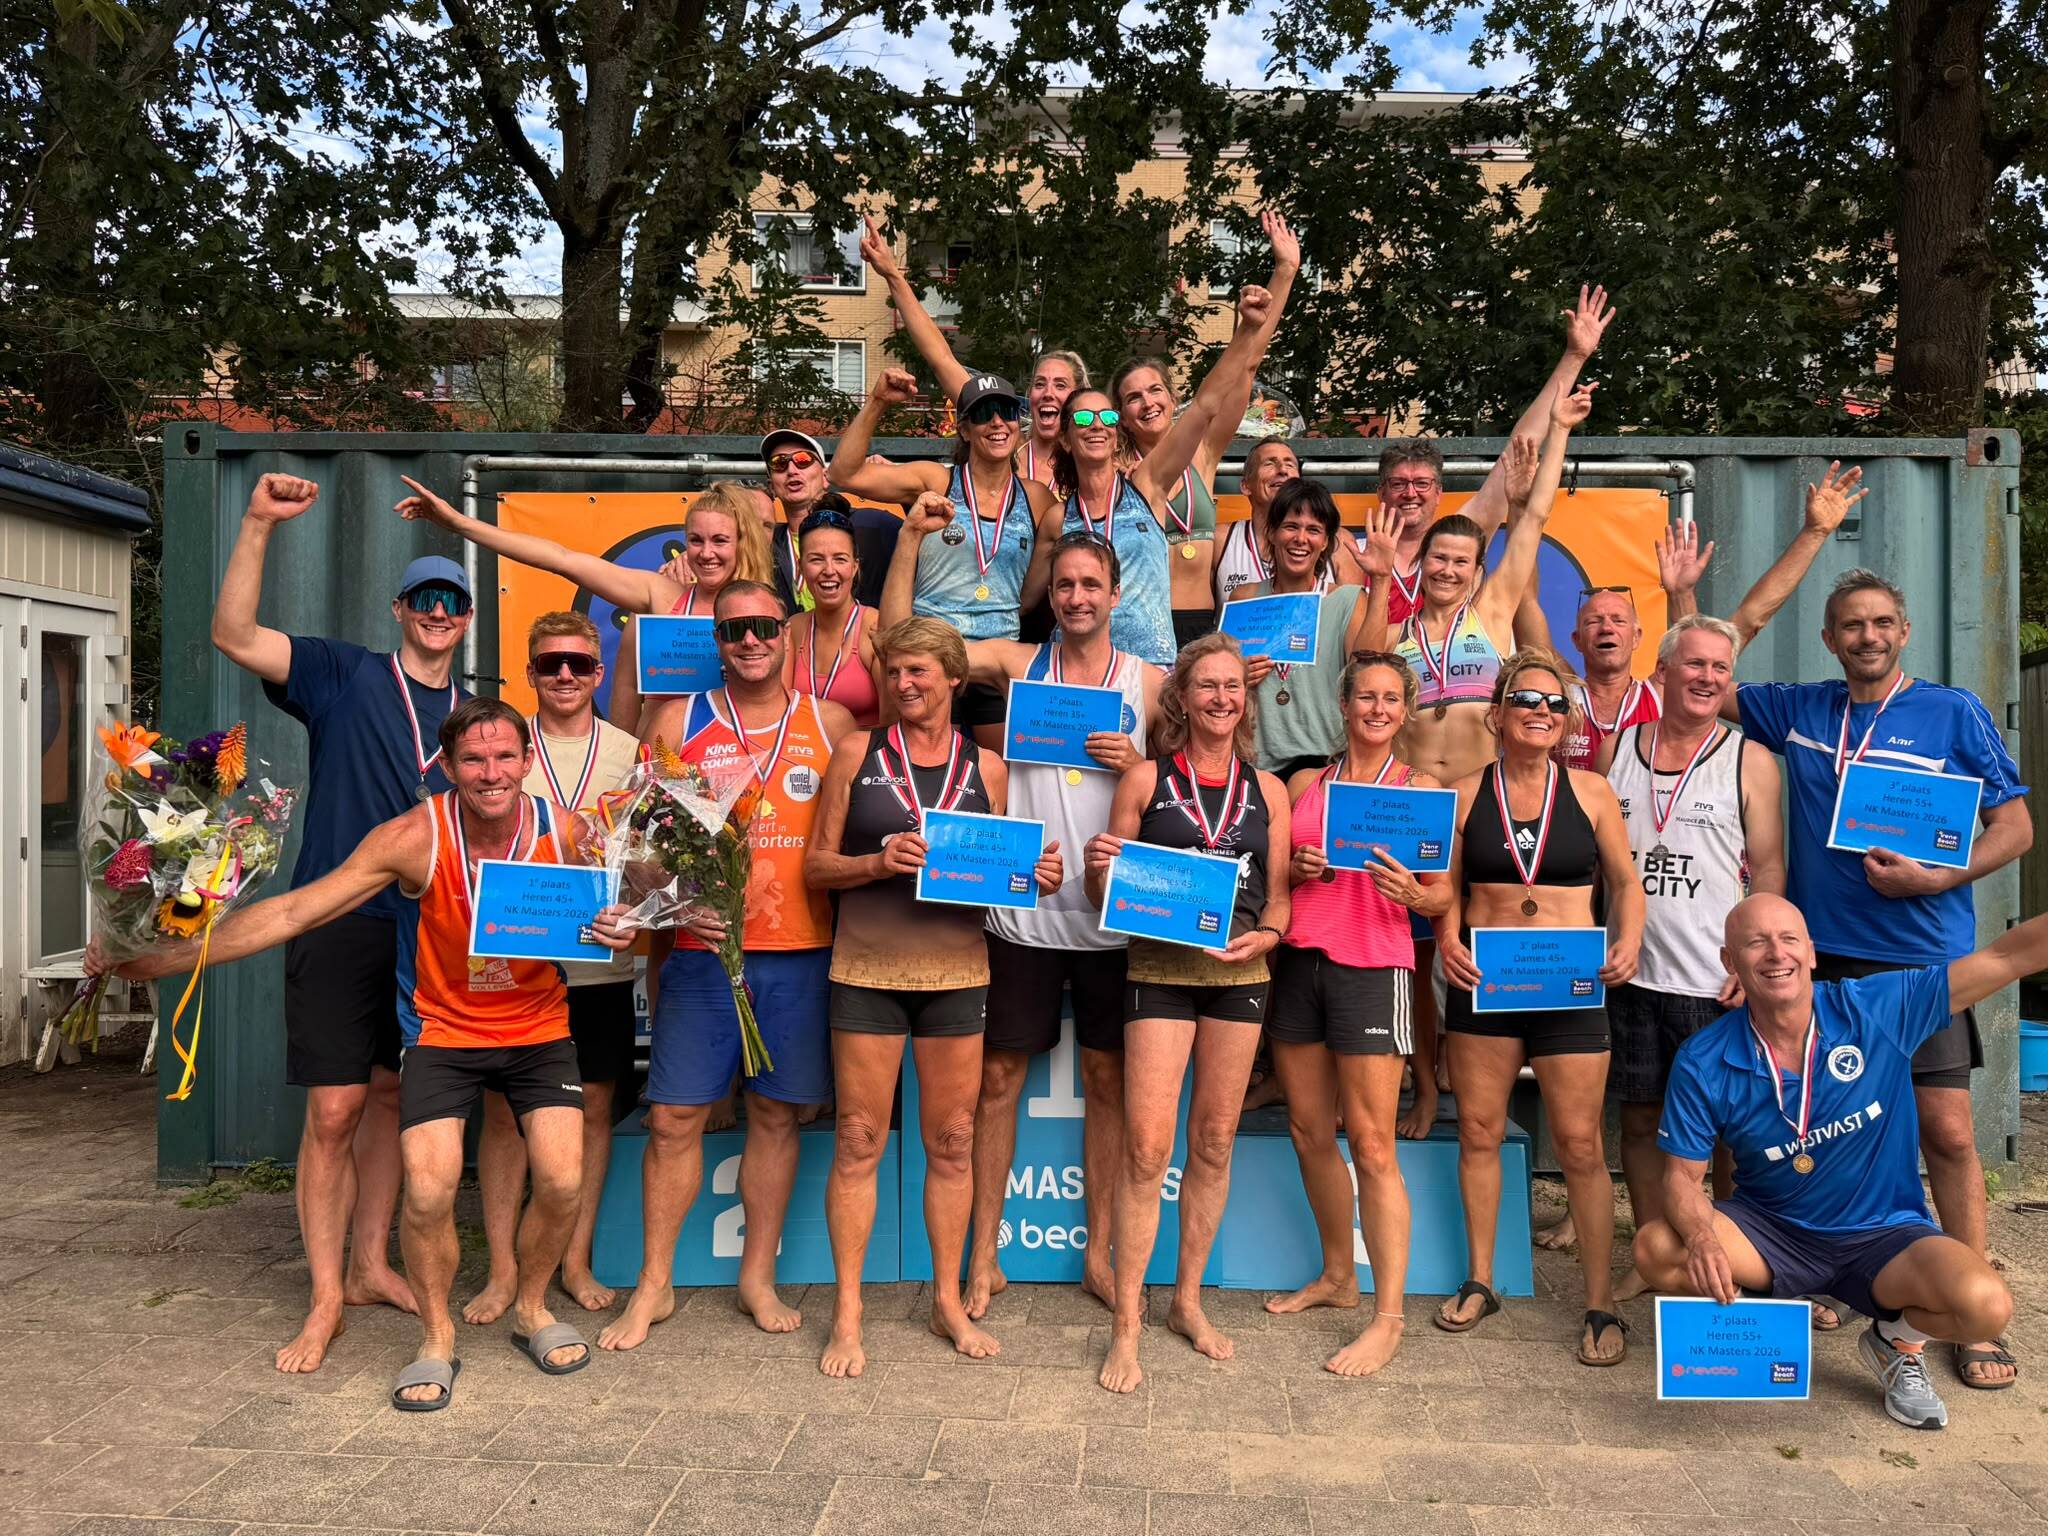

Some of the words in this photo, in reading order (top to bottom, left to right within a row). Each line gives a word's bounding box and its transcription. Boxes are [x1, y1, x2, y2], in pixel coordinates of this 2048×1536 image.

[1167, 535, 1184, 543] NIK
[687, 629, 712, 638] plaats
[672, 640, 700, 648] Dames
[661, 652, 672, 660] NK
[674, 652, 706, 660] Masters
[1450, 664, 1483, 676] CITY
[1058, 697, 1084, 707] plaats
[1044, 708, 1068, 718] Heren
[1071, 710, 1085, 719] 35+
[1029, 719, 1041, 727] NK
[1043, 721, 1076, 731] Masters
[1078, 724, 1098, 733] 2026
[1887, 736, 1915, 746] Amr
[701, 757, 741, 770] COURT
[872, 776, 909, 784] nevob
[1901, 782, 1931, 795] plaats
[1382, 800, 1410, 810] plaats
[1883, 793, 1912, 806] Heren
[1914, 798, 1933, 808] 55+
[1364, 811, 1396, 821] Dames
[1398, 814, 1415, 823] 45+
[1864, 804, 1878, 813] NK
[1880, 807, 1920, 821] Masters
[1922, 812, 1948, 824] 2026
[977, 830, 1002, 839] plaats
[1350, 824, 1363, 832] NK
[1366, 825, 1402, 835] Masters
[1405, 827, 1428, 836] 2026
[960, 840, 988, 851] Dames
[992, 843, 1007, 852] 45+
[946, 853, 958, 861] NK
[961, 854, 995, 865] Masters
[998, 858, 1019, 867] 2026
[1644, 852, 1693, 876] BET
[1168, 863, 1194, 875] plaats
[541, 879, 571, 889] plaats
[1642, 875, 1702, 899] CITY
[522, 892, 552, 903] Heren
[555, 894, 573, 904] 45+
[1149, 886, 1185, 901] Masters
[1187, 894, 1209, 905] 2026
[504, 905, 518, 914] NK
[521, 906, 561, 918] Masters
[563, 909, 589, 919] 2026
[1531, 941, 1559, 951] plaats
[1513, 954, 1546, 963] Dames
[1548, 954, 1566, 962] 45+
[1501, 967, 1513, 975] NK
[1516, 967, 1554, 975] Masters
[1556, 966, 1580, 975] 2026
[1364, 1027, 1390, 1035] adidas
[1785, 1111, 1863, 1155] WESTVAST
[1004, 1166, 1183, 1201] MASS
[1725, 1316, 1757, 1328] plaats
[1707, 1330, 1740, 1341] Heren
[1742, 1331, 1762, 1341] 55+
[1690, 1346, 1705, 1355] NK
[1708, 1345, 1751, 1356] Masters
[1754, 1346, 1781, 1357] 2026
